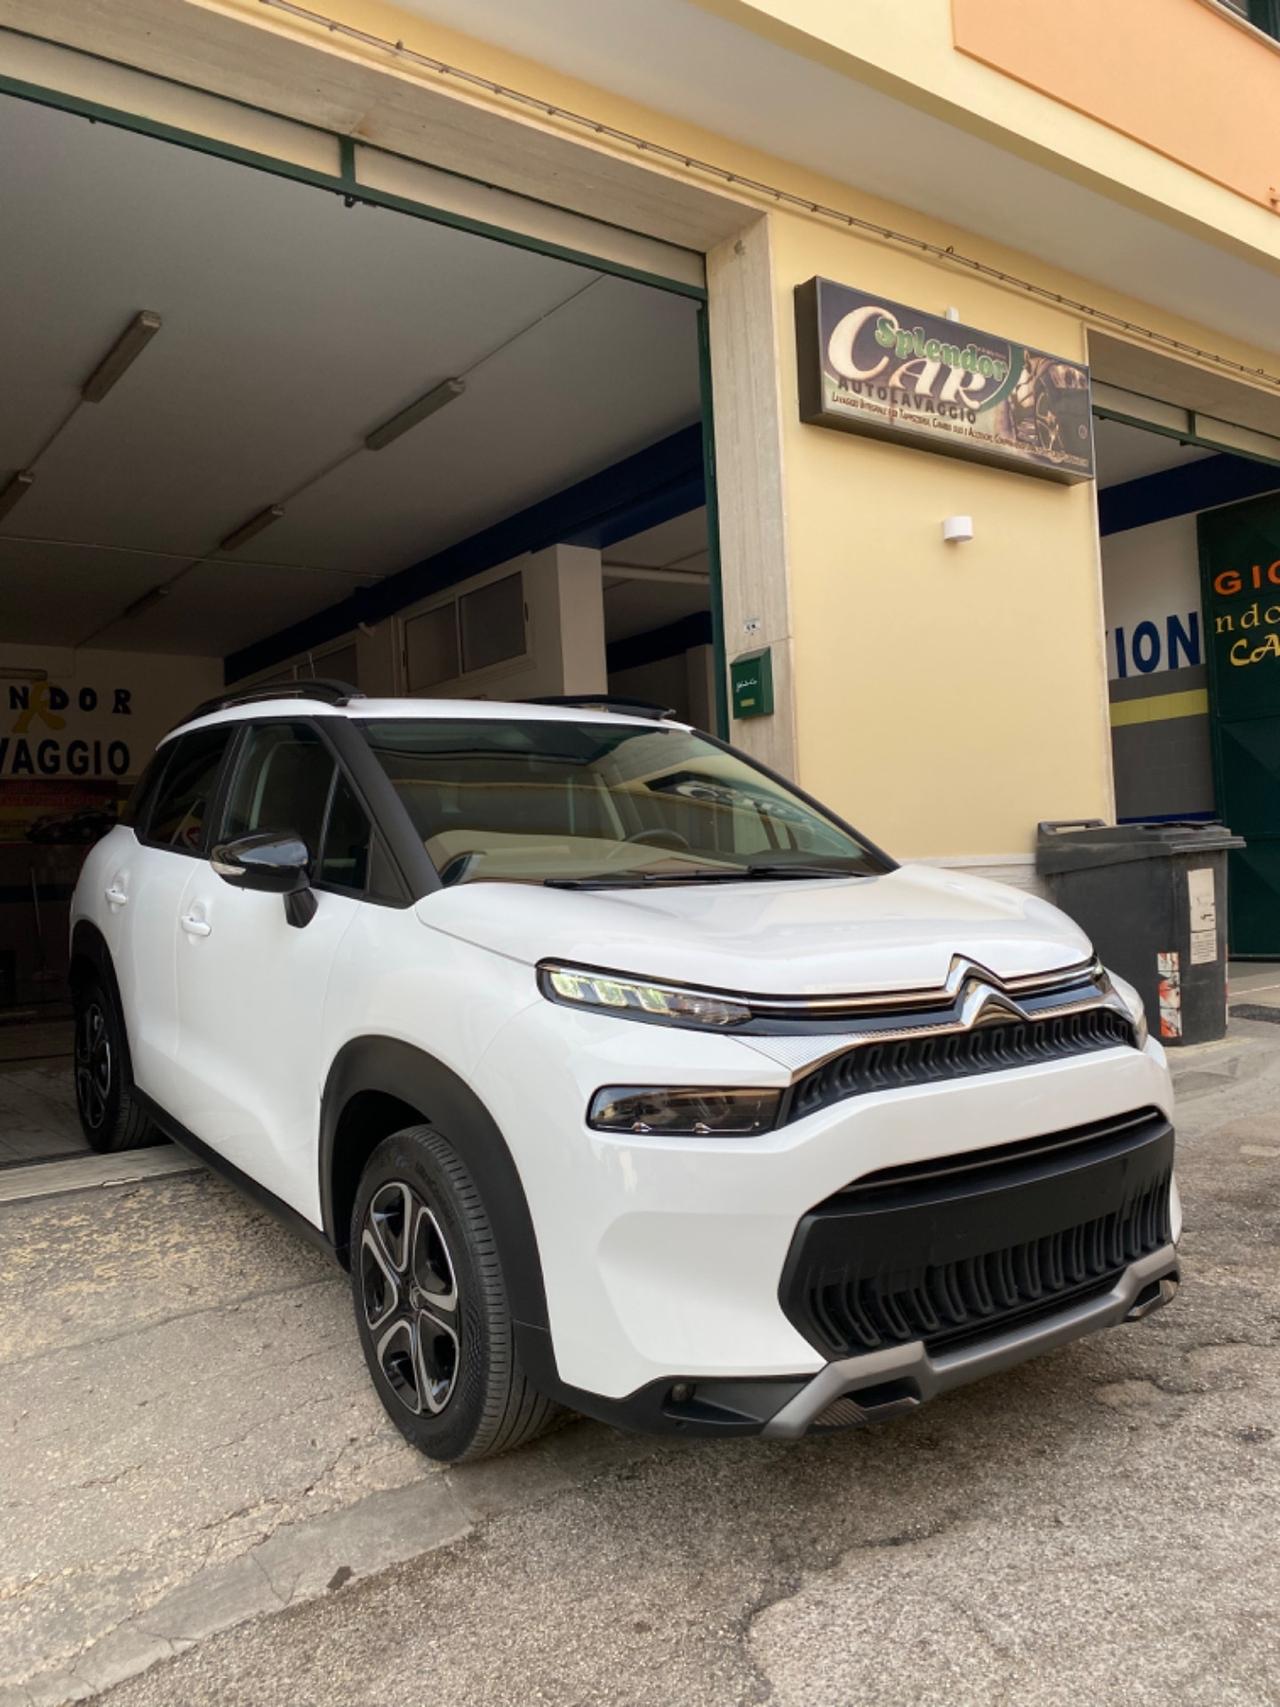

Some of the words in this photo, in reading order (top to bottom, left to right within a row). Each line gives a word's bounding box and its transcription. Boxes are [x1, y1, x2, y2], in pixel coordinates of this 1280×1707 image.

[828, 305, 986, 409] CAR
[875, 316, 1008, 382] Splendor
[838, 376, 976, 424] AUTOLAVAGGIO
[1106, 611, 1201, 678] ION
